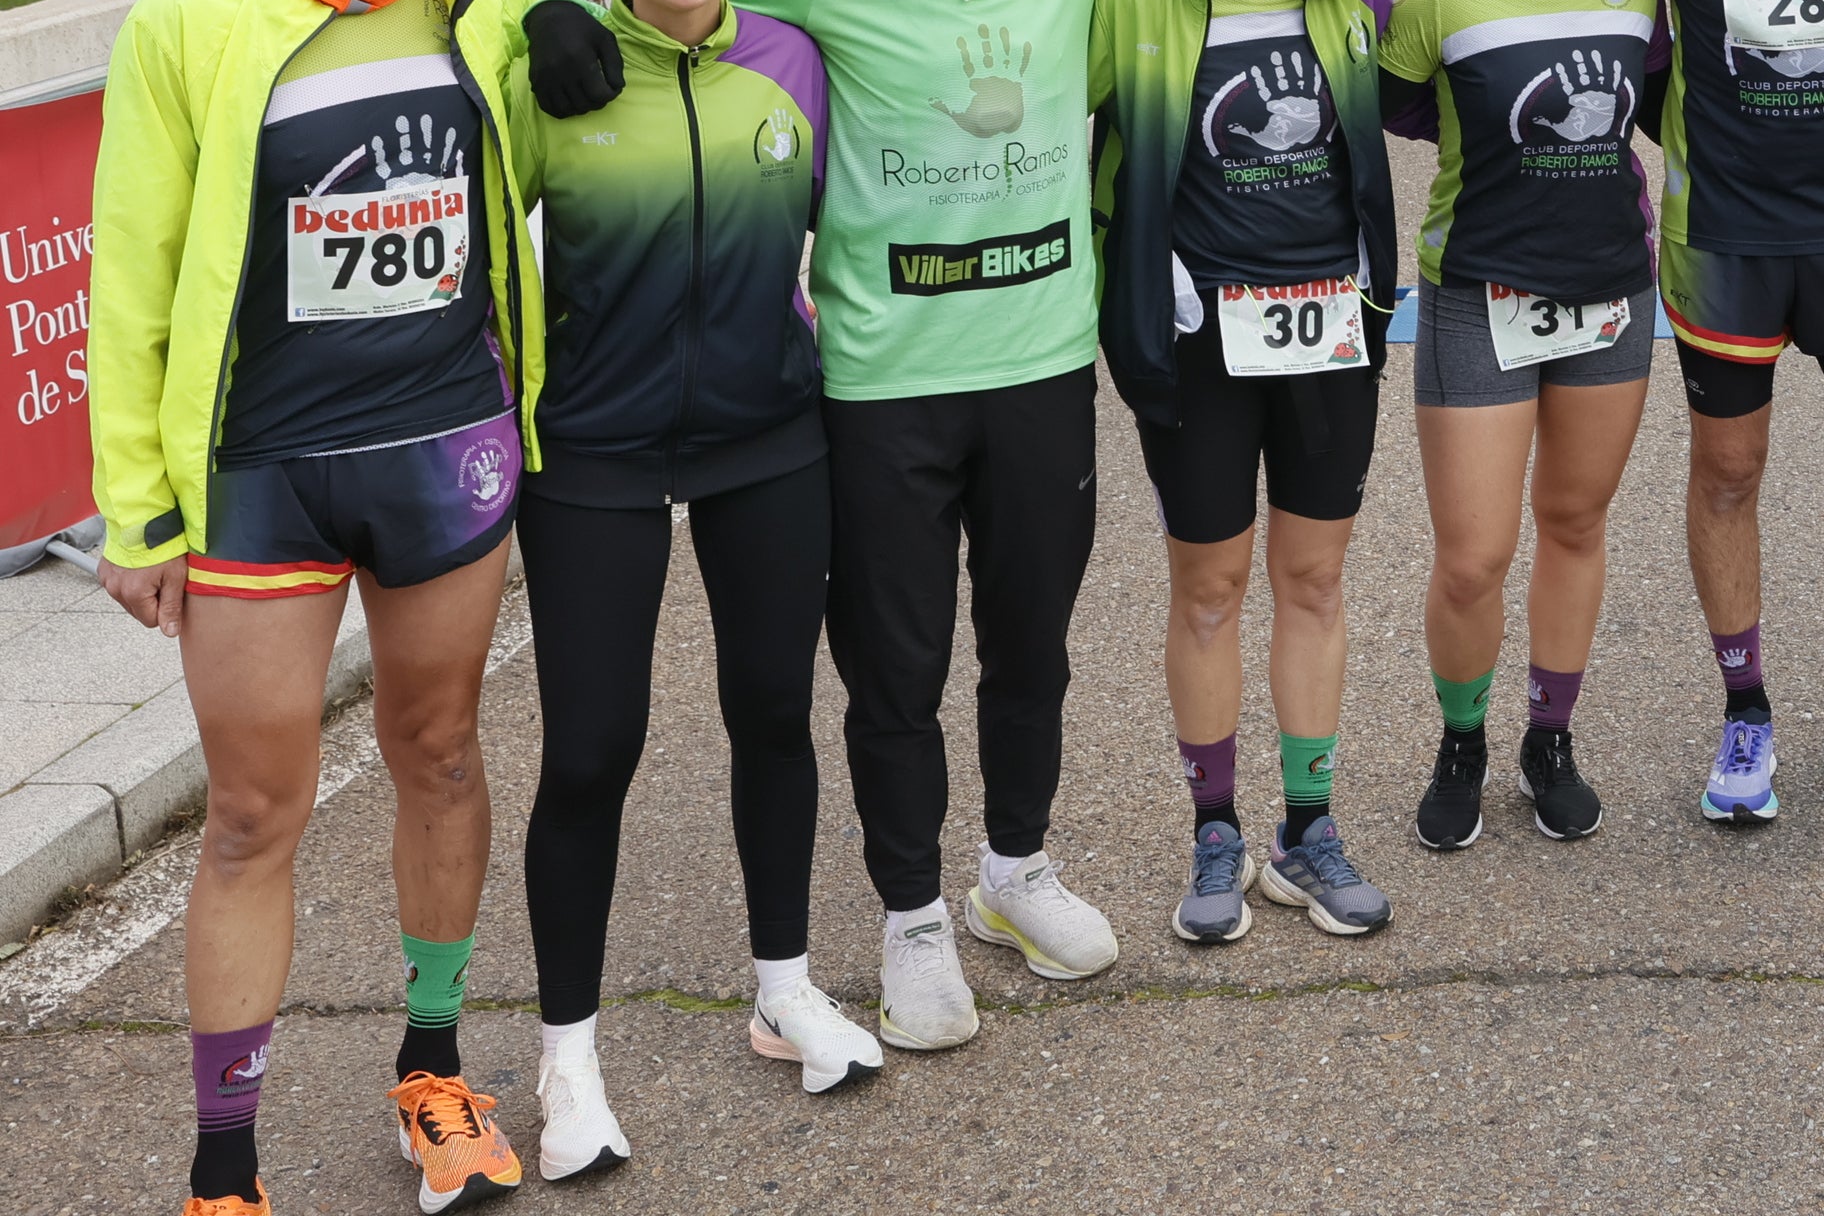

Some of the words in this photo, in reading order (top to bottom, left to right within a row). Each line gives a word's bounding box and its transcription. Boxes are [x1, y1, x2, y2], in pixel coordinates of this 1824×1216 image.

[1739, 80, 1771, 90] CLUB
[1739, 91, 1799, 106] ROBERTO
[1223, 158, 1258, 167] CLUB
[1264, 147, 1325, 165] DEPORTIVO
[1521, 155, 1578, 168] ROBERTO
[1580, 153, 1619, 167] RAMOS
[1523, 145, 1553, 155] CLUB
[1559, 142, 1618, 153] DEPORTIVO
[882, 149, 1000, 187] Roberto
[1006, 142, 1068, 175] Ramos
[1224, 166, 1288, 183] ROBERTO
[1292, 156, 1329, 177] RAMOS
[1521, 169, 1618, 179] FISIOTERAPIA
[1226, 172, 1333, 193] FISIOTERAPIA
[929, 190, 1000, 206] FISIOTERAPIA
[294, 189, 463, 233] bedunia
[323, 226, 445, 290] 780
[899, 255, 978, 285] Villar
[982, 237, 1065, 278] Bikes
[1263, 301, 1324, 349] 30
[1530, 300, 1584, 337] 31
[17, 368, 60, 426] de
